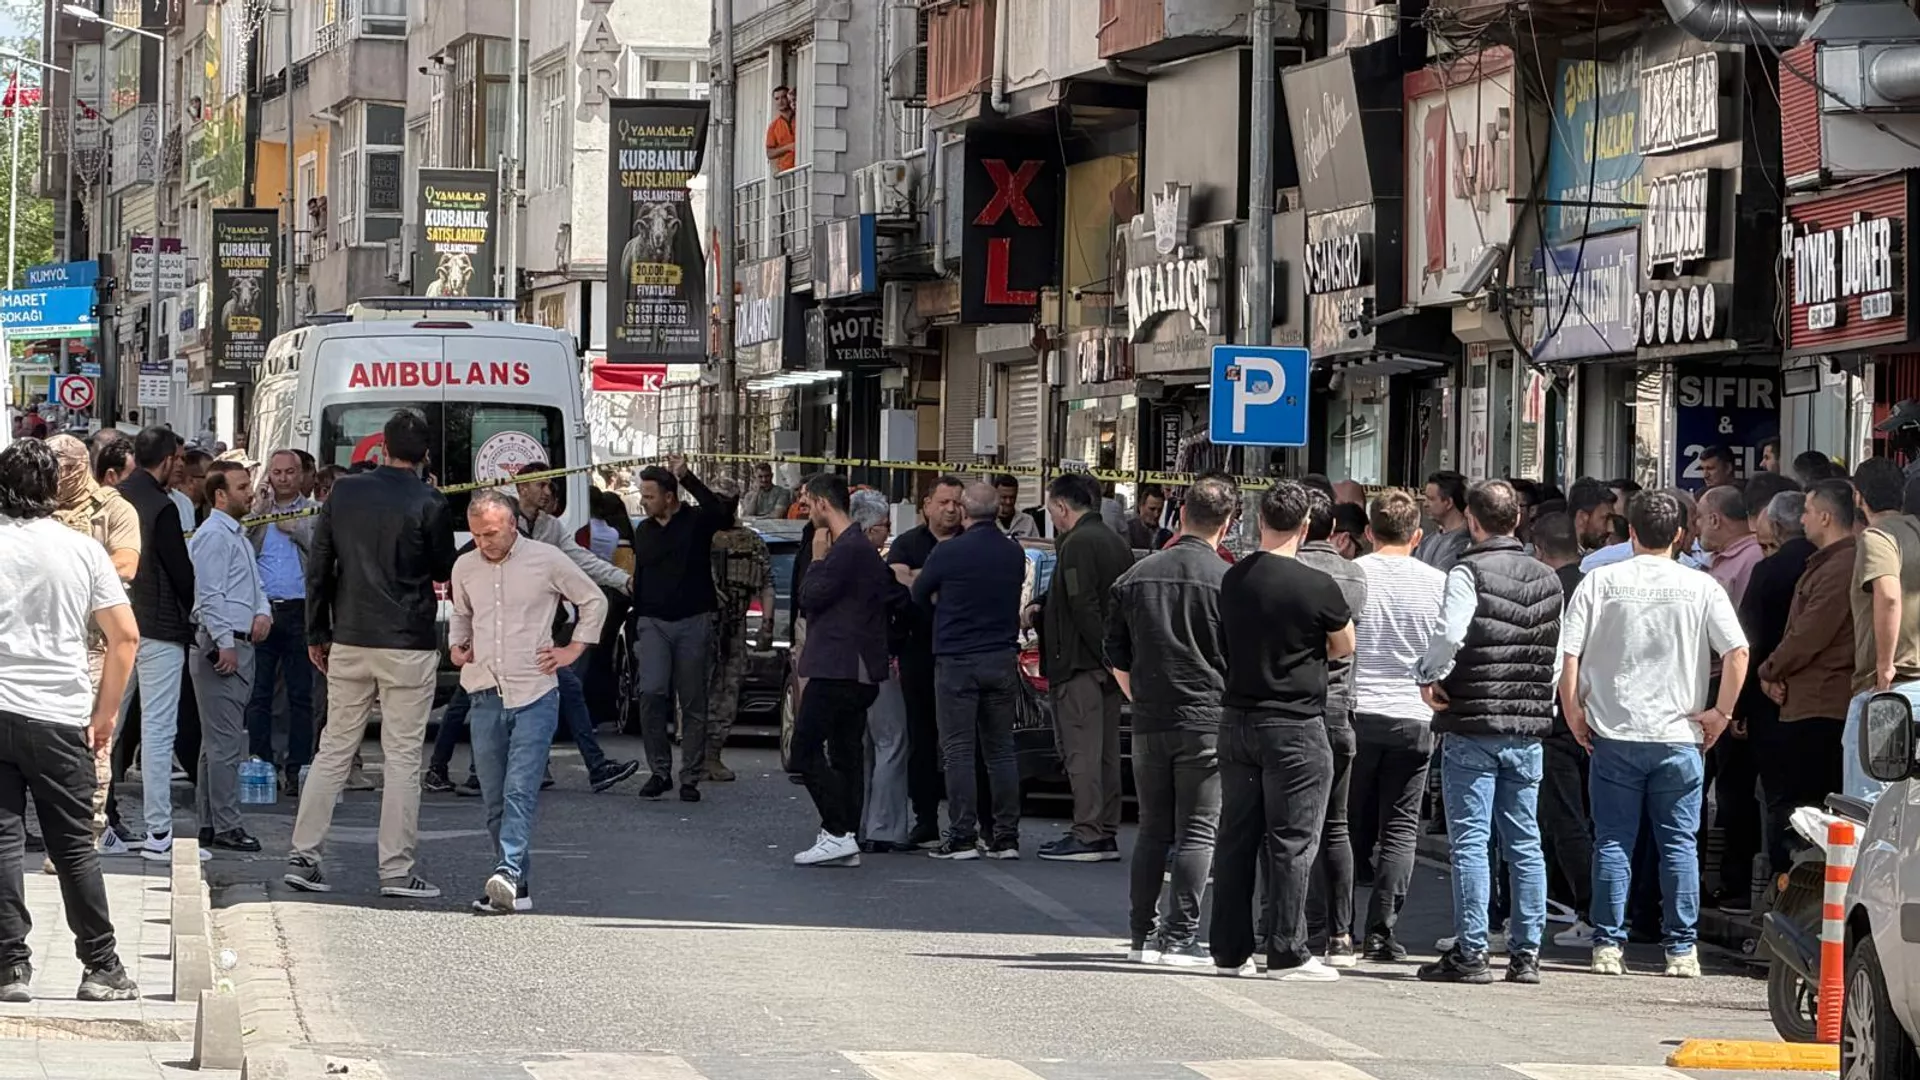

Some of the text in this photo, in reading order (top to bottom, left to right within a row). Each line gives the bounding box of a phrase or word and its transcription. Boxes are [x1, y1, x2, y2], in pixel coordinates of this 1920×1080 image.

[631, 126, 694, 137] YAMANLAR
[619, 149, 698, 171] KURBANLIK
[434, 190, 487, 202] YAMANLAR
[425, 208, 489, 228] KURBANLIK
[426, 227, 486, 243] SATIŞLARIMIZ
[219, 242, 272, 257] KURBANLIK
[1794, 223, 1836, 305] DİYAR
[1842, 211, 1891, 296] DÖNER
[29, 268, 69, 284] KUMYOL
[0, 310, 42, 323] SOKAĞI
[348, 362, 532, 389] AMBULANS
[1232, 356, 1286, 434] P
[1679, 375, 1775, 409] SIFIR
[1718, 416, 1734, 434] &
[1682, 444, 1706, 479] 2
[1598, 586, 1696, 599] FUTURE IS FREEDOM
